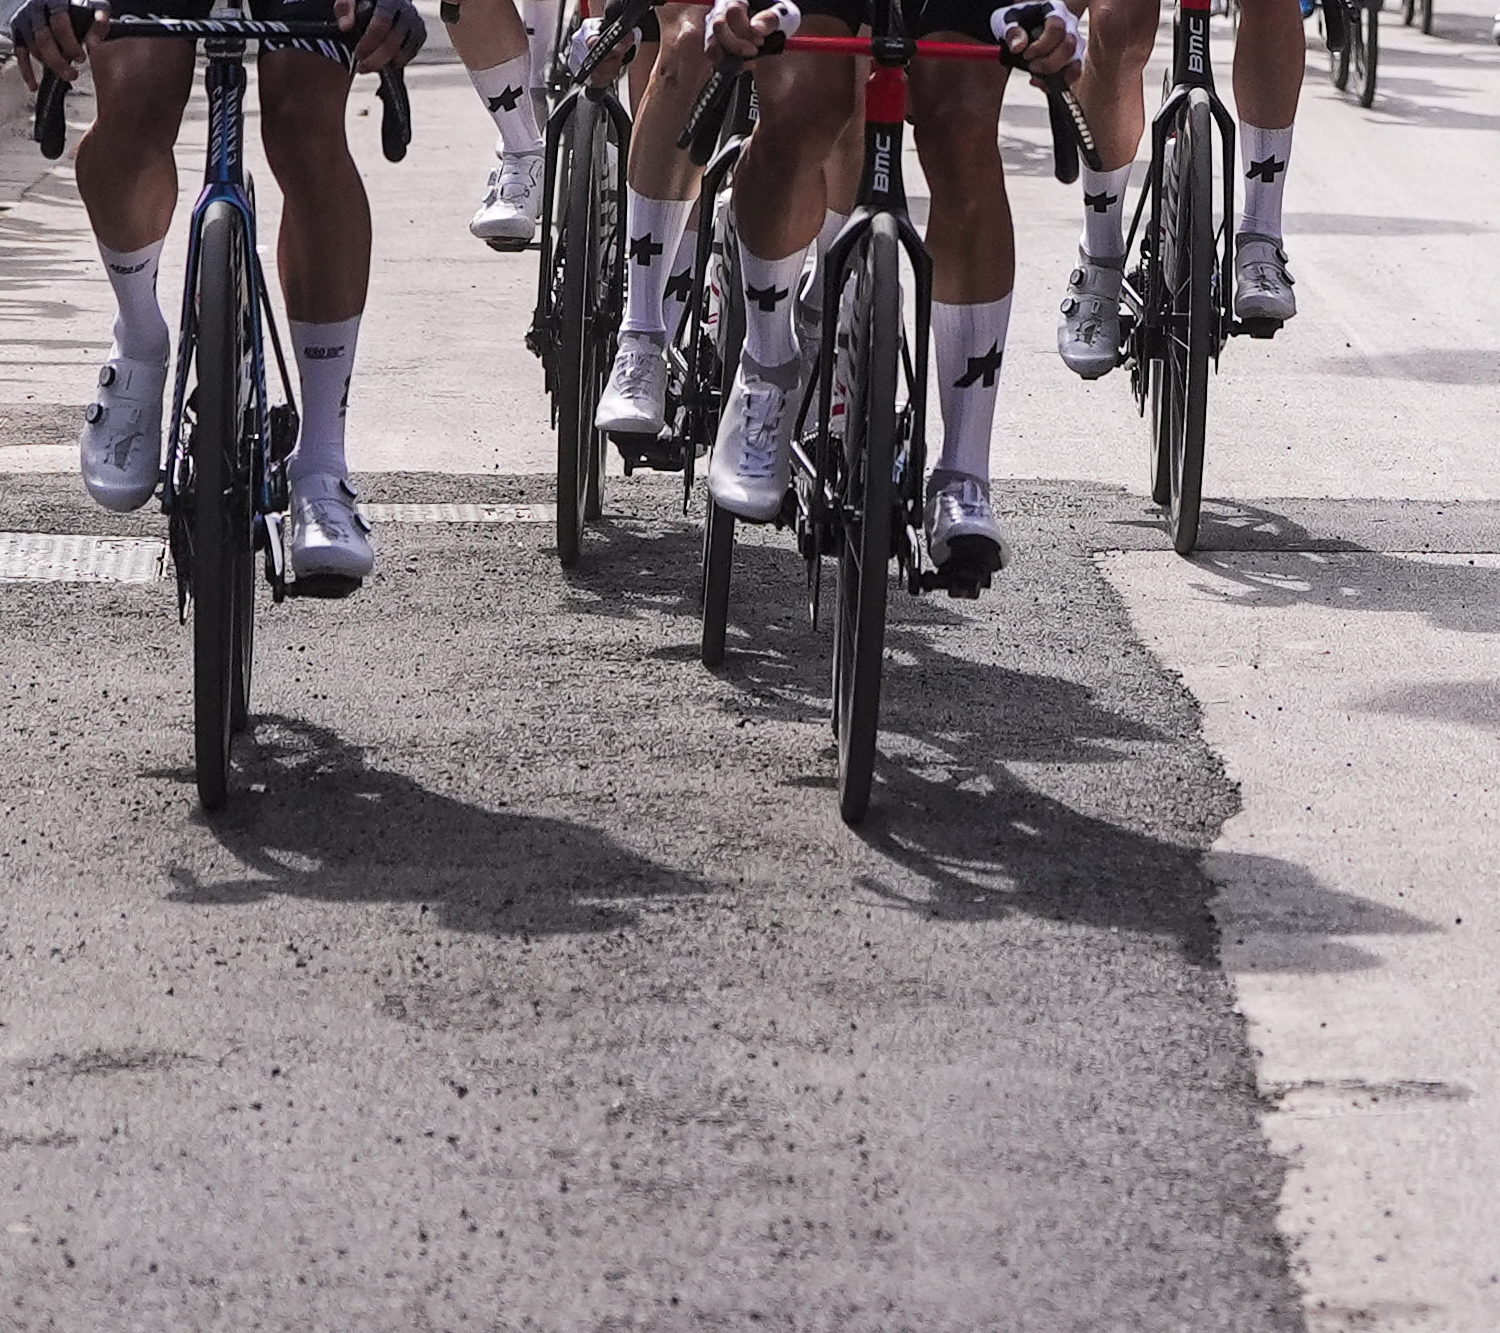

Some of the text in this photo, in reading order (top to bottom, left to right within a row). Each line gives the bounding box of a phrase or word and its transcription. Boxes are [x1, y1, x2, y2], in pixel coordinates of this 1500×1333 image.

[1187, 15, 1207, 75] BMC
[1059, 89, 1095, 152] SRAM
[871, 132, 891, 193] BMC
